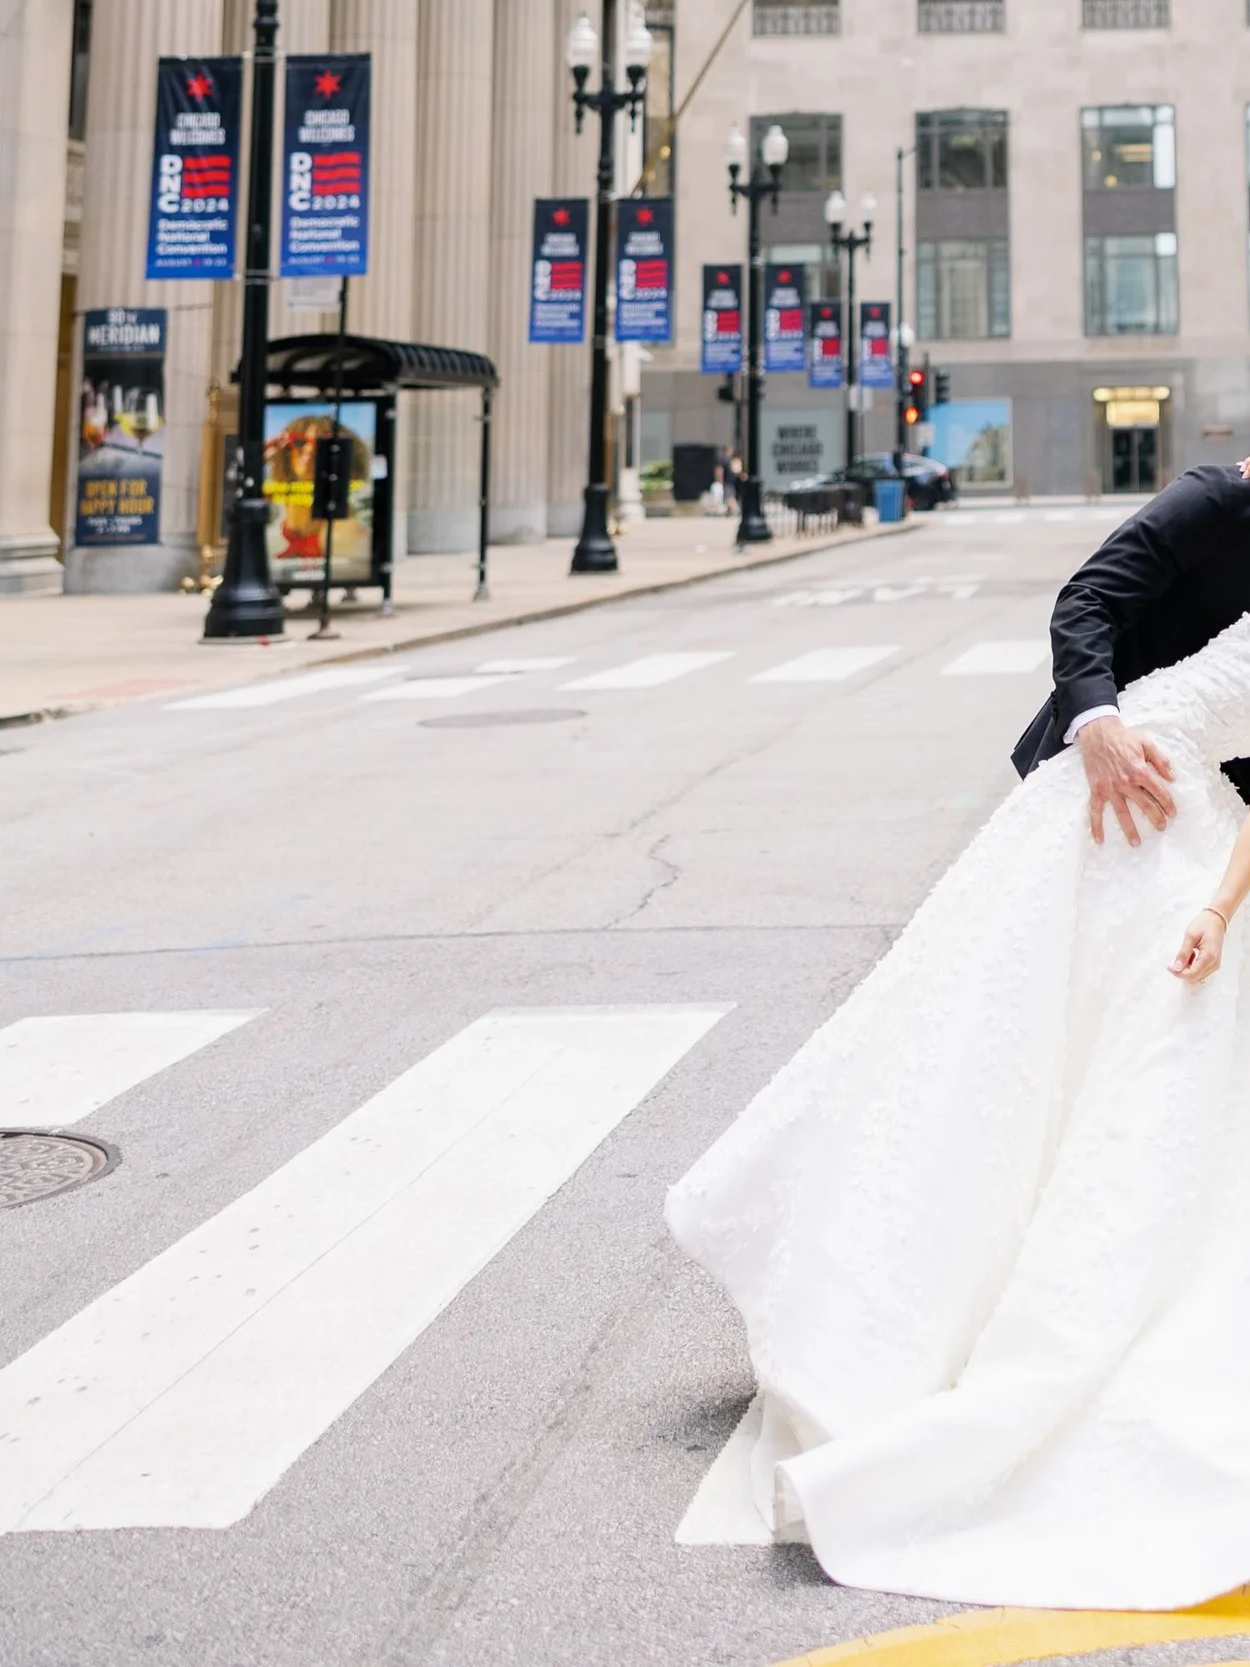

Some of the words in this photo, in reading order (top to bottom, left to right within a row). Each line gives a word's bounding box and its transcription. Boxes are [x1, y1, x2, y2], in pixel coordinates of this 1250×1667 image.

[180, 198, 229, 213] 2024
[311, 195, 361, 210] 2024
[88, 325, 160, 346] MERIDIAN
